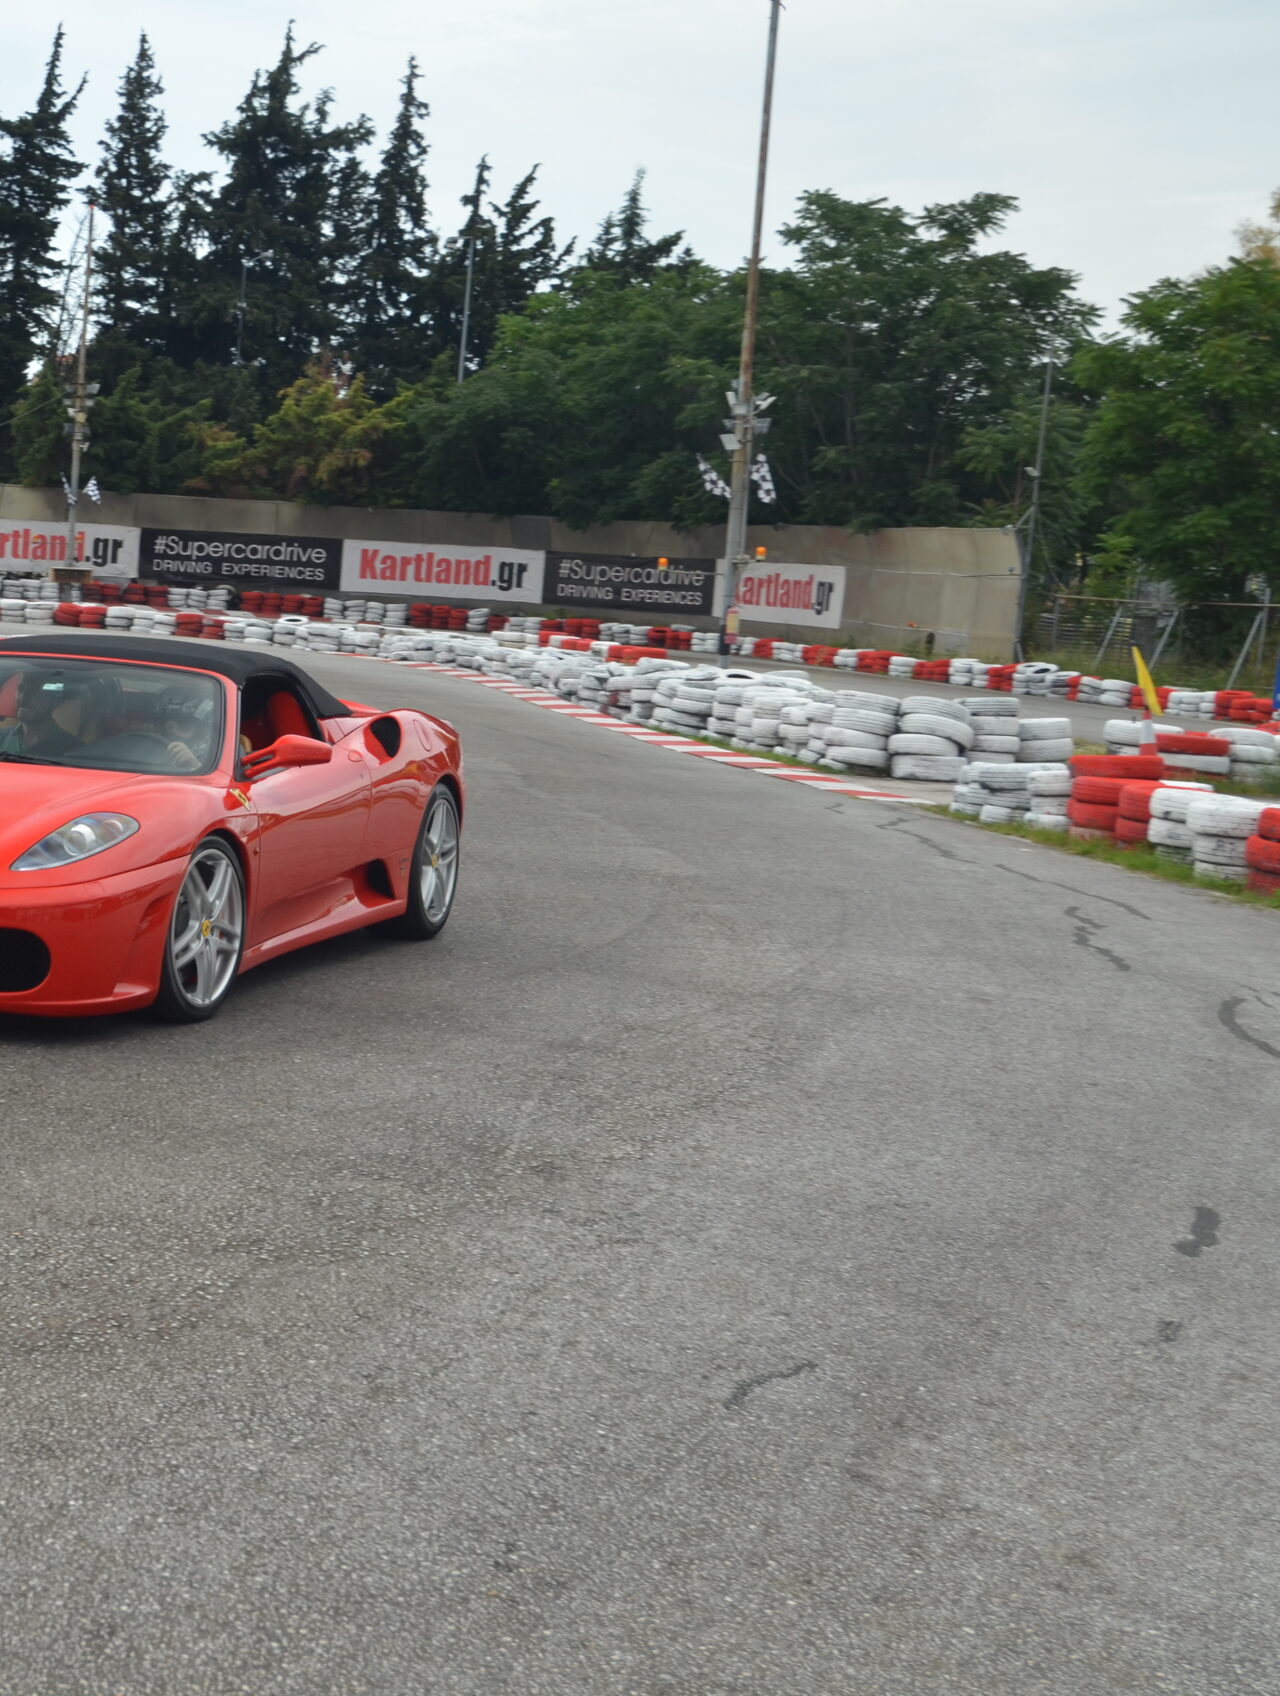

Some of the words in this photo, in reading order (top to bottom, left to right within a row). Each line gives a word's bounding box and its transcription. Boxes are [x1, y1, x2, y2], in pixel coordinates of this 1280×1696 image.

[153, 535, 327, 563] #Supercardrive
[153, 559, 212, 574] DRIVING
[221, 562, 325, 581] EXPERIENCES
[358, 548, 528, 592] Kartland.gr
[558, 559, 705, 586] #Supercardrive
[557, 583, 613, 600] DRIVING
[621, 588, 703, 605] EXPERIENCES
[734, 572, 834, 616] artland.gr
